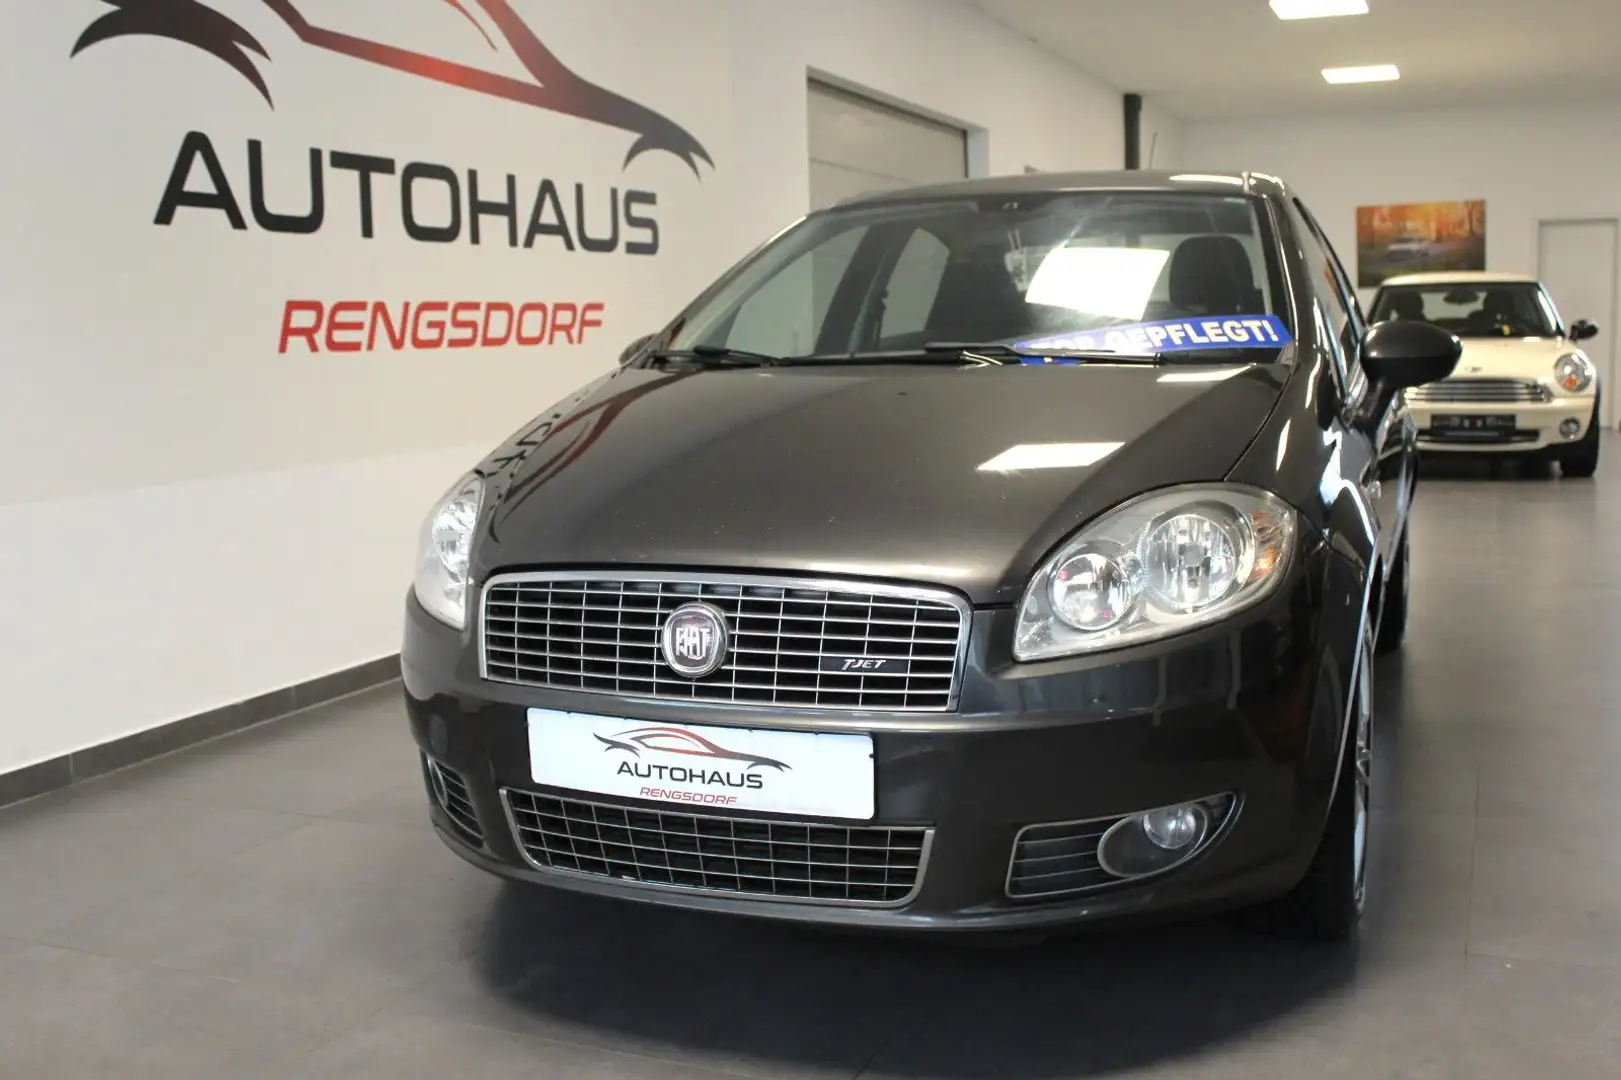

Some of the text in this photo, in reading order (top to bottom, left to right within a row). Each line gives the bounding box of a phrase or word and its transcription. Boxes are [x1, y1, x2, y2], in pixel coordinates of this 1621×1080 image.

[152, 130, 660, 256] AUTOHAUS
[277, 299, 605, 354] RENGSDORF
[1102, 319, 1279, 351] GEPFLEGT!
[675, 627, 711, 661] FIAT
[616, 761, 764, 790] AUTOHAUS
[639, 786, 738, 806] RENGSDORF
